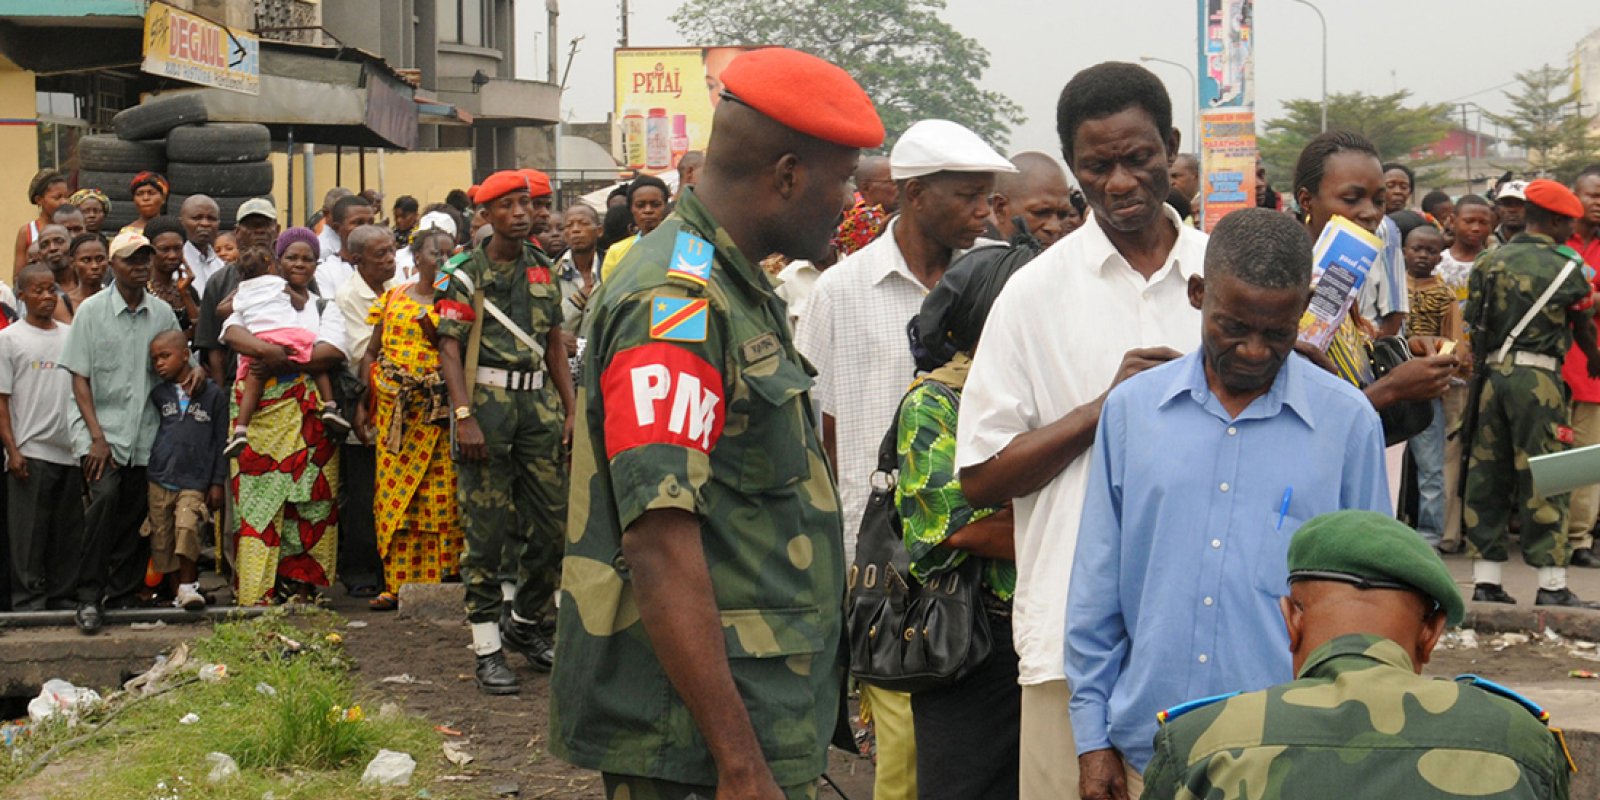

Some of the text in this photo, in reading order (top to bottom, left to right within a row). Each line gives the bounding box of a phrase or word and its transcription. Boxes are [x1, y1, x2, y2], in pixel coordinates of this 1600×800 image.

[169, 12, 225, 71] DEGAUL
[632, 72, 683, 98] PETAL
[631, 364, 720, 450] PM
